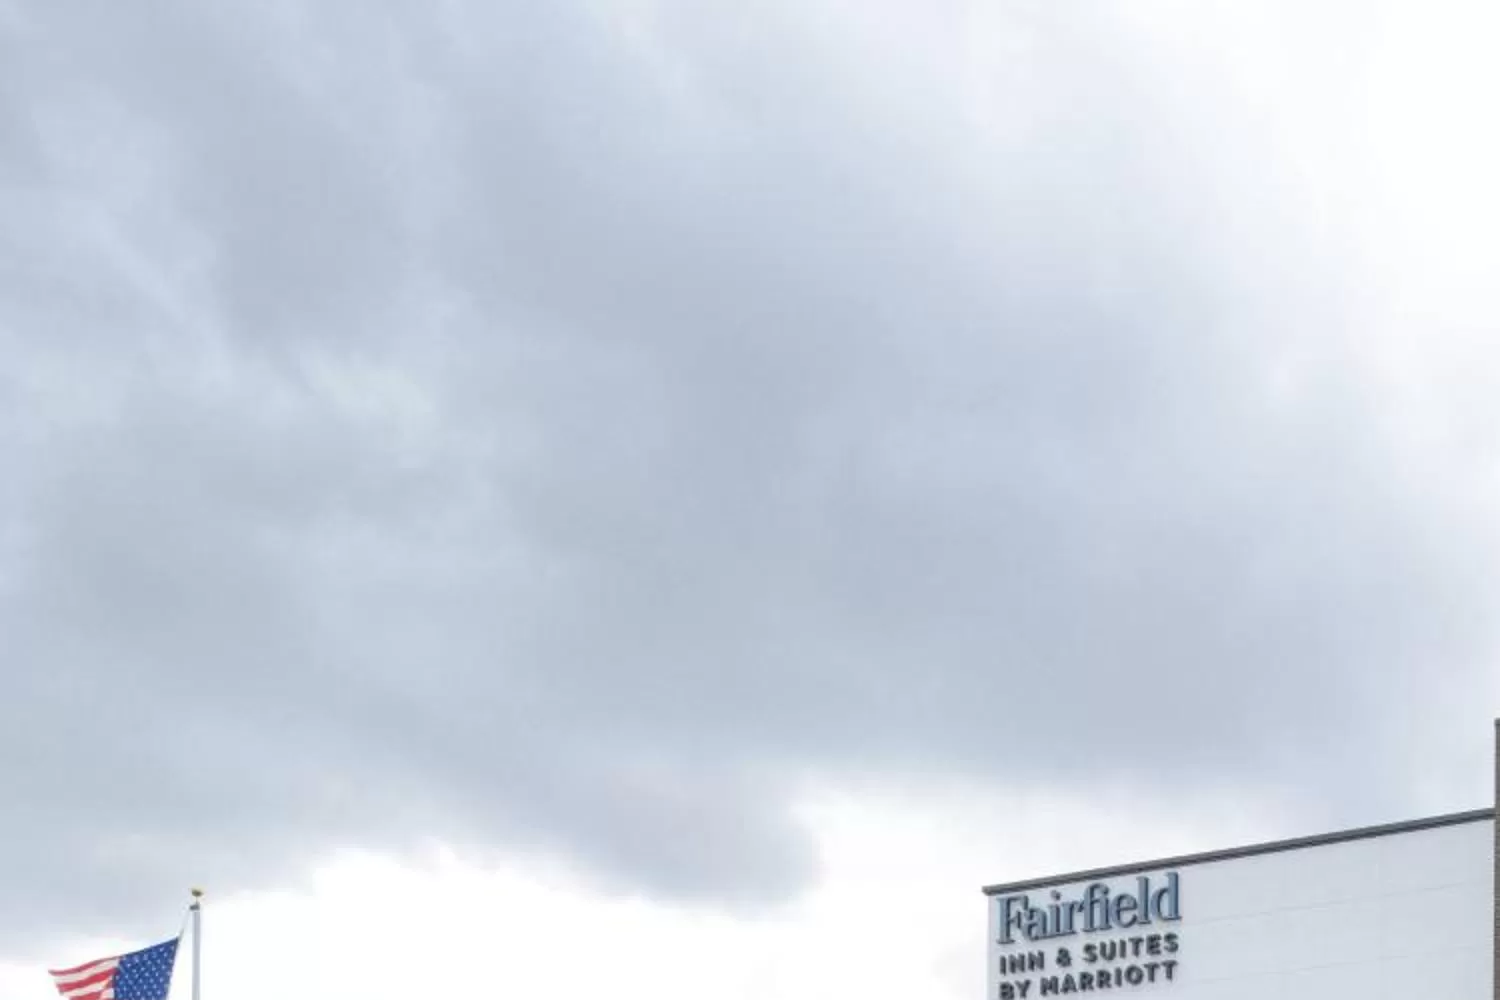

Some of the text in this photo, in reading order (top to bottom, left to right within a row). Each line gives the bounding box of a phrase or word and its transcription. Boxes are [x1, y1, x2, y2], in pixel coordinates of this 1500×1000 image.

[996, 872, 1182, 944] Fairfield
[999, 933, 1180, 976] INN & SUITES
[999, 960, 1178, 1000] BY MARRIOTT
